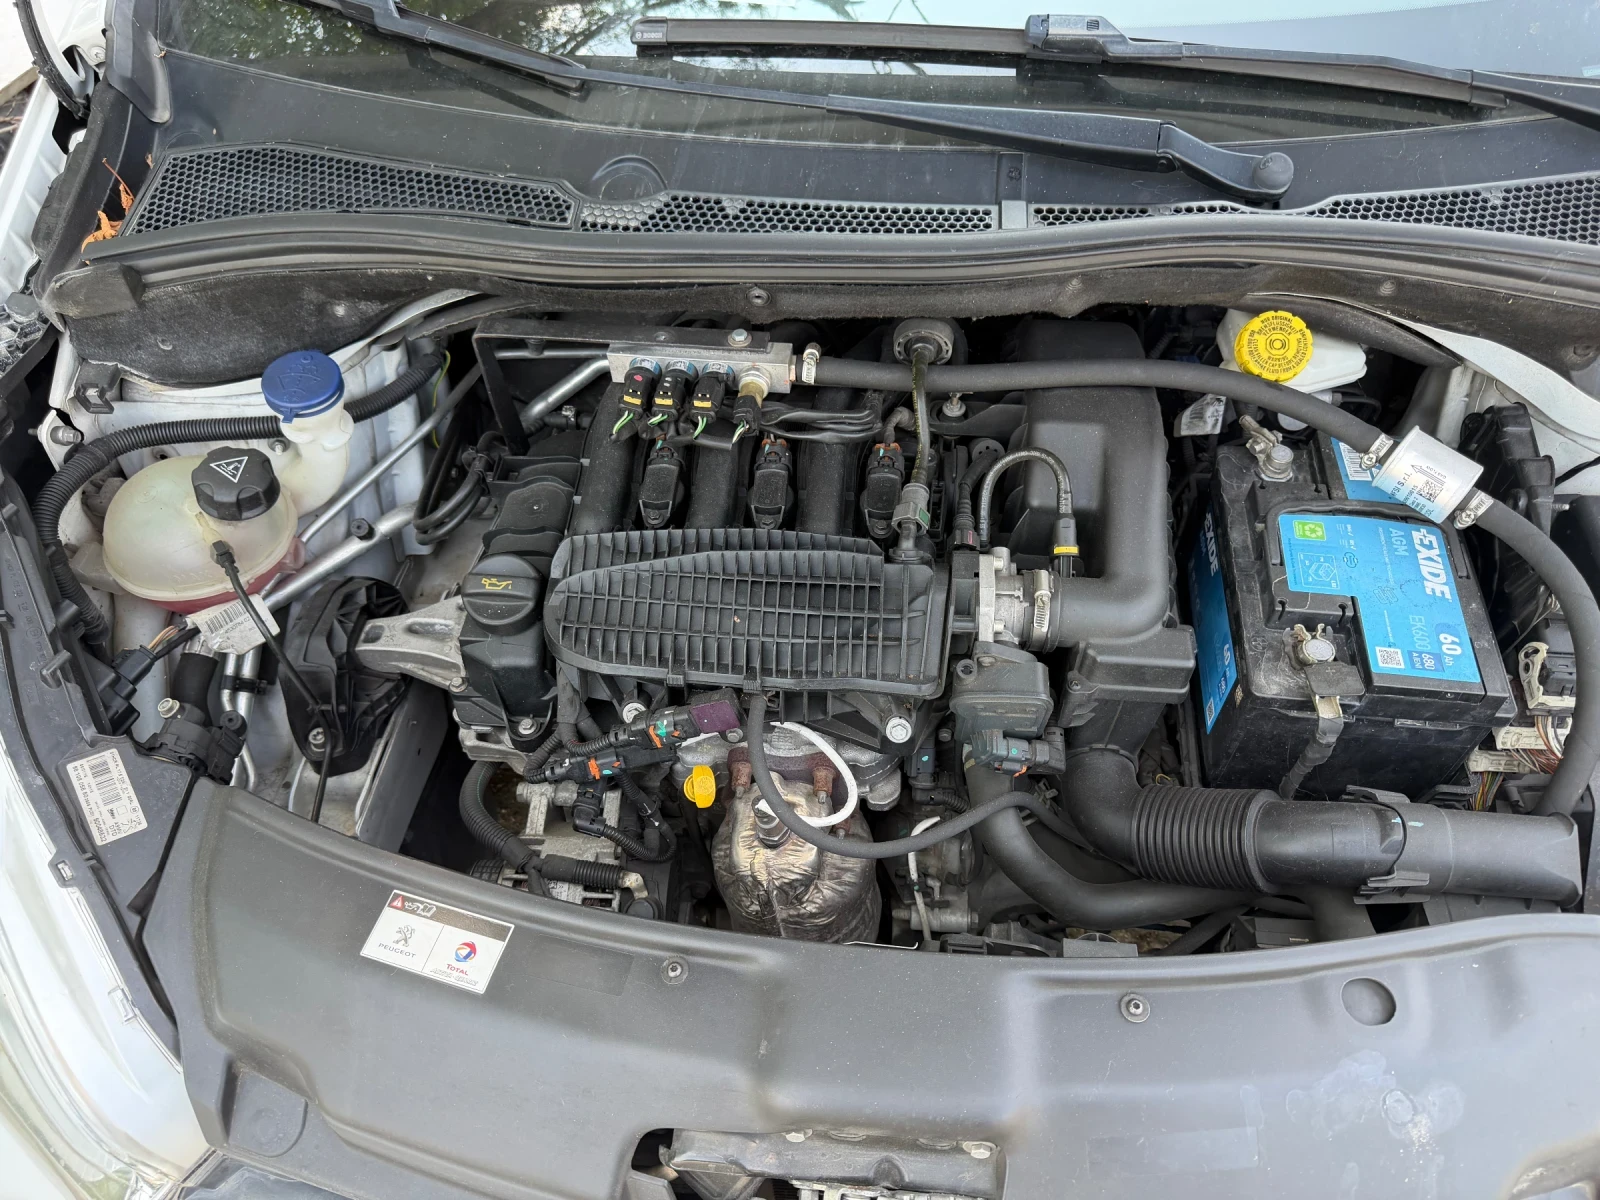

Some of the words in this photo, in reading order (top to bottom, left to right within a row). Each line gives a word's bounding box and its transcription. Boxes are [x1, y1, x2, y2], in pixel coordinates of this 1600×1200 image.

[1263, 327, 1293, 336] VERWENDEN
[1257, 352, 1268, 366] FILLER
[1205, 512, 1220, 576] EXIDE
[1389, 528, 1409, 556] AGM
[1412, 528, 1452, 602] EXIDE
[1408, 614, 1430, 650] EK600
[1223, 643, 1231, 666] 60
[1439, 633, 1462, 655] 60
[1421, 653, 1435, 670] 680
[1443, 655, 1454, 666] Ah
[378, 942, 416, 958] PEUGEOT
